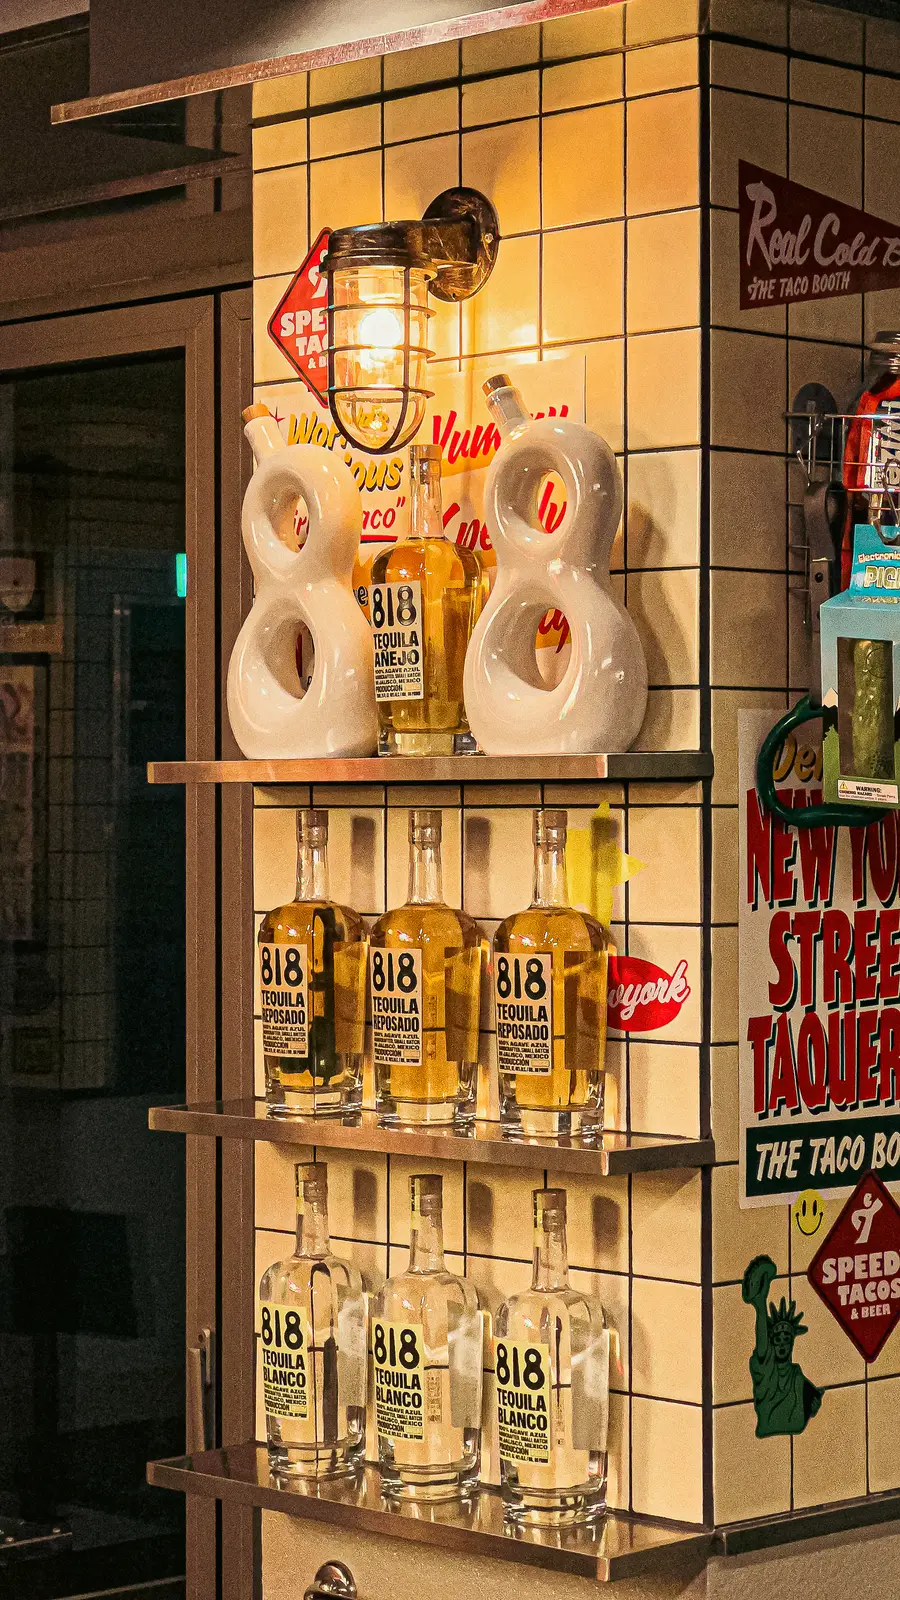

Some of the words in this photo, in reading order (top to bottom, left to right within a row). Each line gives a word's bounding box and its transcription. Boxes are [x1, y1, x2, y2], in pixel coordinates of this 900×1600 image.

[746, 181, 812, 271] Real
[814, 213, 880, 266] Cold
[748, 276, 777, 300] THE
[780, 276, 807, 297] TACO
[812, 270, 851, 294] BOOTH
[373, 586, 416, 628] 818
[373, 631, 419, 650] TEQUILA
[375, 649, 419, 667] AÑEJO
[747, 788, 836, 909] NEW
[262, 946, 303, 987] 818
[373, 951, 417, 993] 818
[497, 956, 546, 1000] 818
[261, 990, 305, 1007] TEQUILA
[373, 996, 419, 1014] TEQUILA
[262, 1008, 305, 1025] REPOSADO
[373, 1014, 419, 1032] REPOSADO
[497, 1003, 548, 1022] TEQUILA
[498, 1022, 549, 1041] REPOSADO
[756, 1139, 803, 1182] THE
[809, 1134, 865, 1176] TACO
[838, 1278, 900, 1306] TACOS
[850, 1308, 859, 1320] &
[861, 1303, 891, 1318] BEER
[261, 1307, 303, 1350] 818
[374, 1324, 420, 1369] 818
[262, 1348, 305, 1370] TEQUILA
[496, 1343, 545, 1390] 818
[263, 1366, 306, 1387] BLANCO
[375, 1367, 421, 1390] TEQUILA
[376, 1385, 422, 1408] BLANCO
[497, 1387, 546, 1412] TEQUILA
[498, 1406, 548, 1431] BLANCO
[510, 1428, 528, 1436] AGAVE
[525, 1442, 548, 1450] MEXICO
